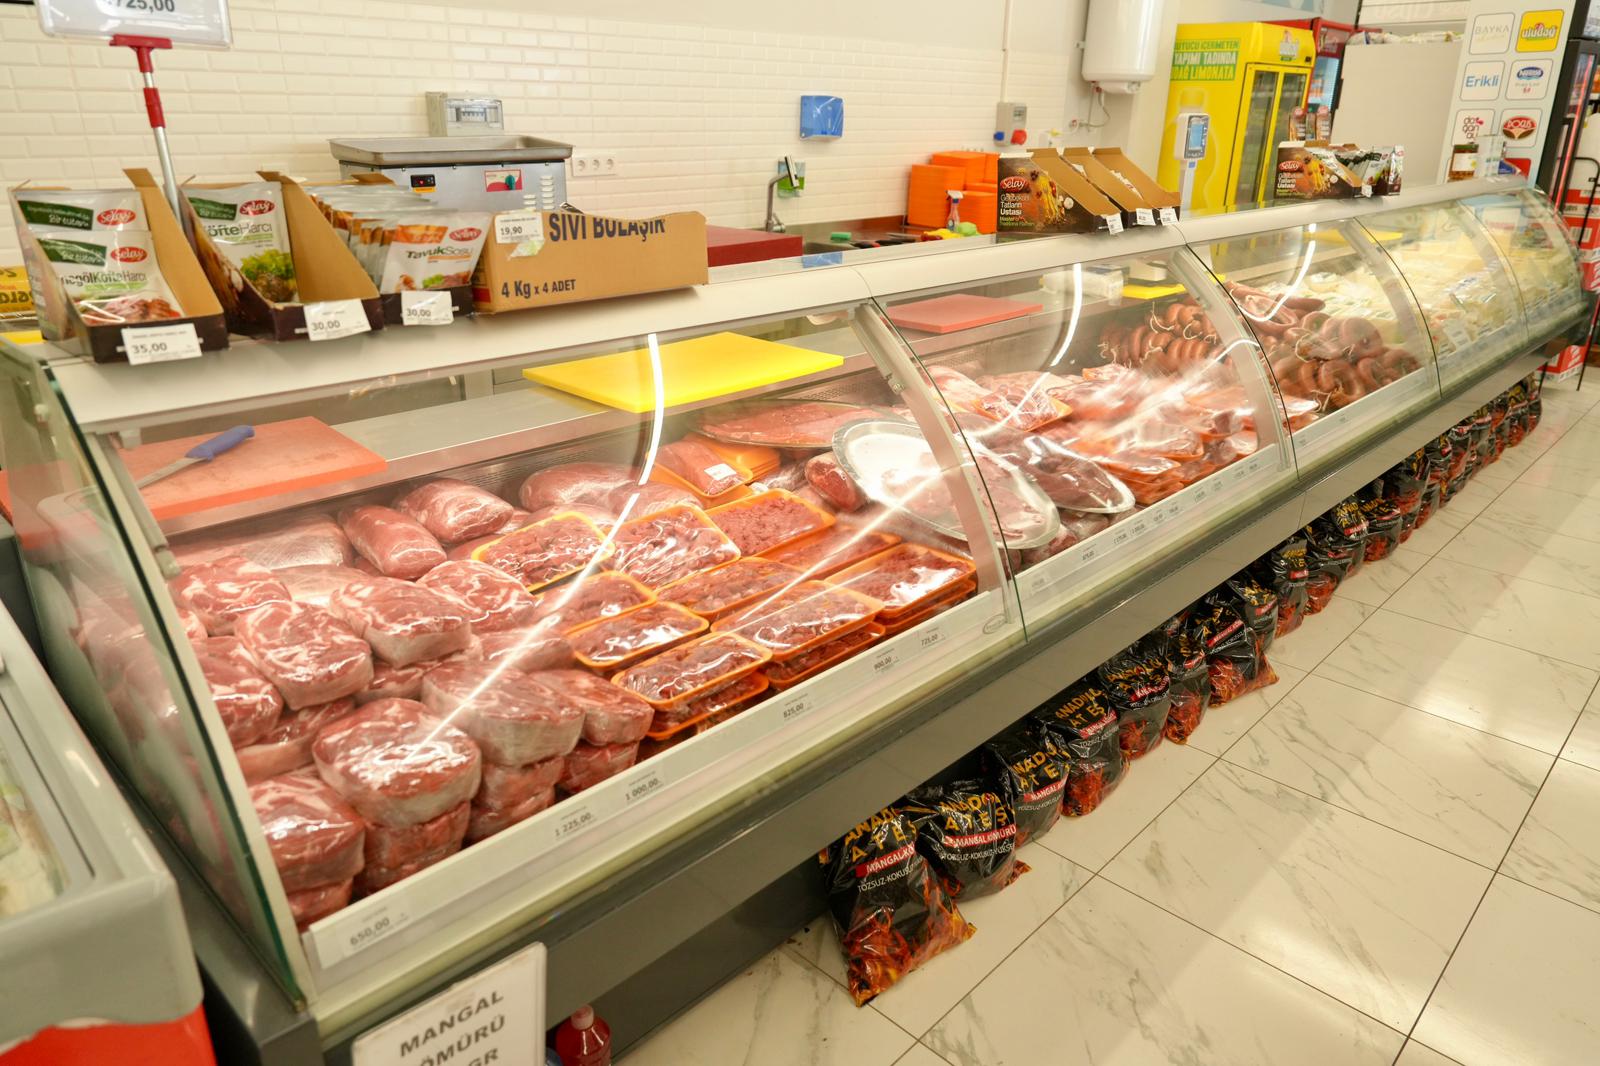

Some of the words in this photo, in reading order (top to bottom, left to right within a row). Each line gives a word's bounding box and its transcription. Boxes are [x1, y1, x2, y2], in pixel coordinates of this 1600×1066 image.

[1475, 25, 1510, 34] BAYKA
[1465, 75, 1500, 88] Erikli
[1003, 178, 1026, 190] Selay
[206, 223, 273, 237] öfteHarcı
[500, 226, 523, 236] 19,90
[549, 212, 587, 242] SIVI
[501, 281, 510, 298] 4
[514, 279, 532, 300] Kg
[534, 286, 540, 295] x
[542, 281, 549, 294] 4
[552, 278, 576, 293] ADET
[131, 343, 168, 355] 35,00
[401, 990, 504, 1058] MANGAL
[419, 1014, 506, 1066] ÖMÜRÜ
